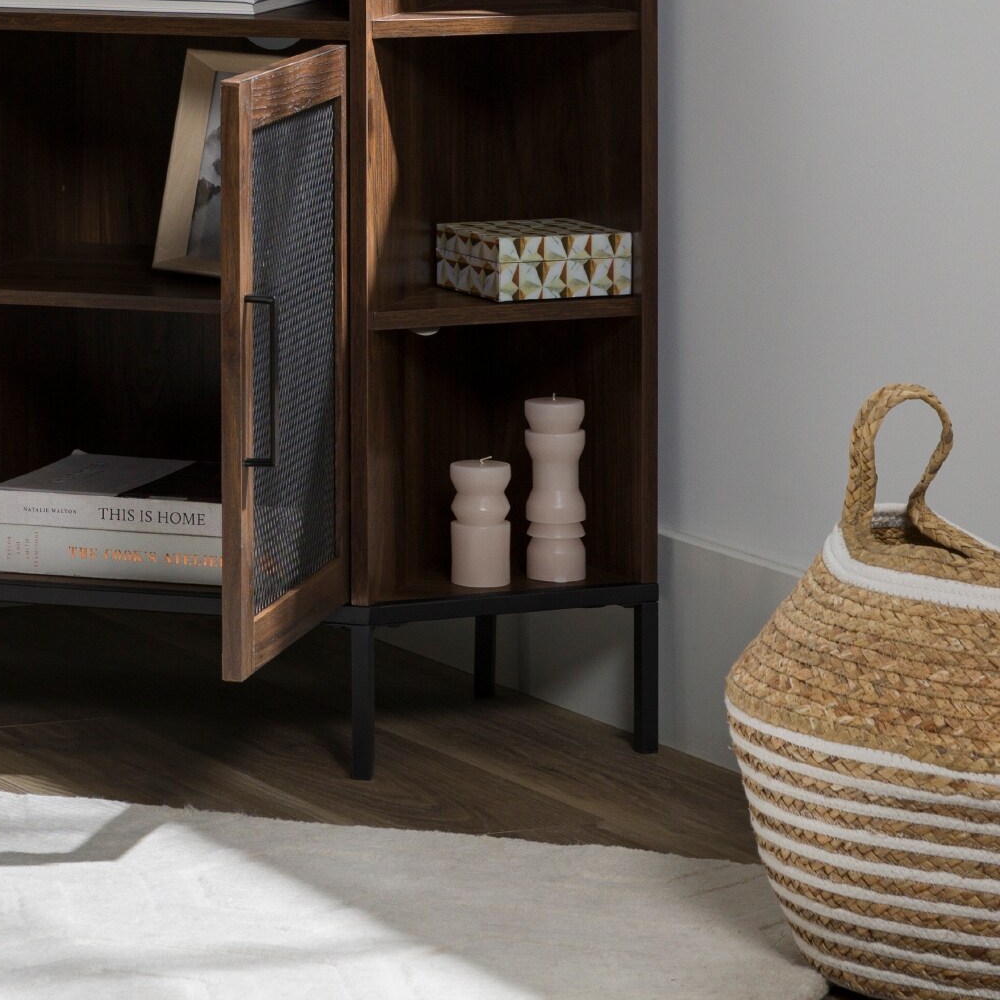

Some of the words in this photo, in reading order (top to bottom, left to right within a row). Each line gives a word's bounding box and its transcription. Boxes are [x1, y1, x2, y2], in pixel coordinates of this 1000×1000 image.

[23, 506, 50, 514] NATALIE
[98, 507, 135, 522] THIS
[140, 510, 153, 523] IS
[157, 511, 206, 526] HOME
[68, 546, 98, 560] THE
[104, 547, 157, 563] COOK'S
[164, 552, 222, 567] ATELIE
